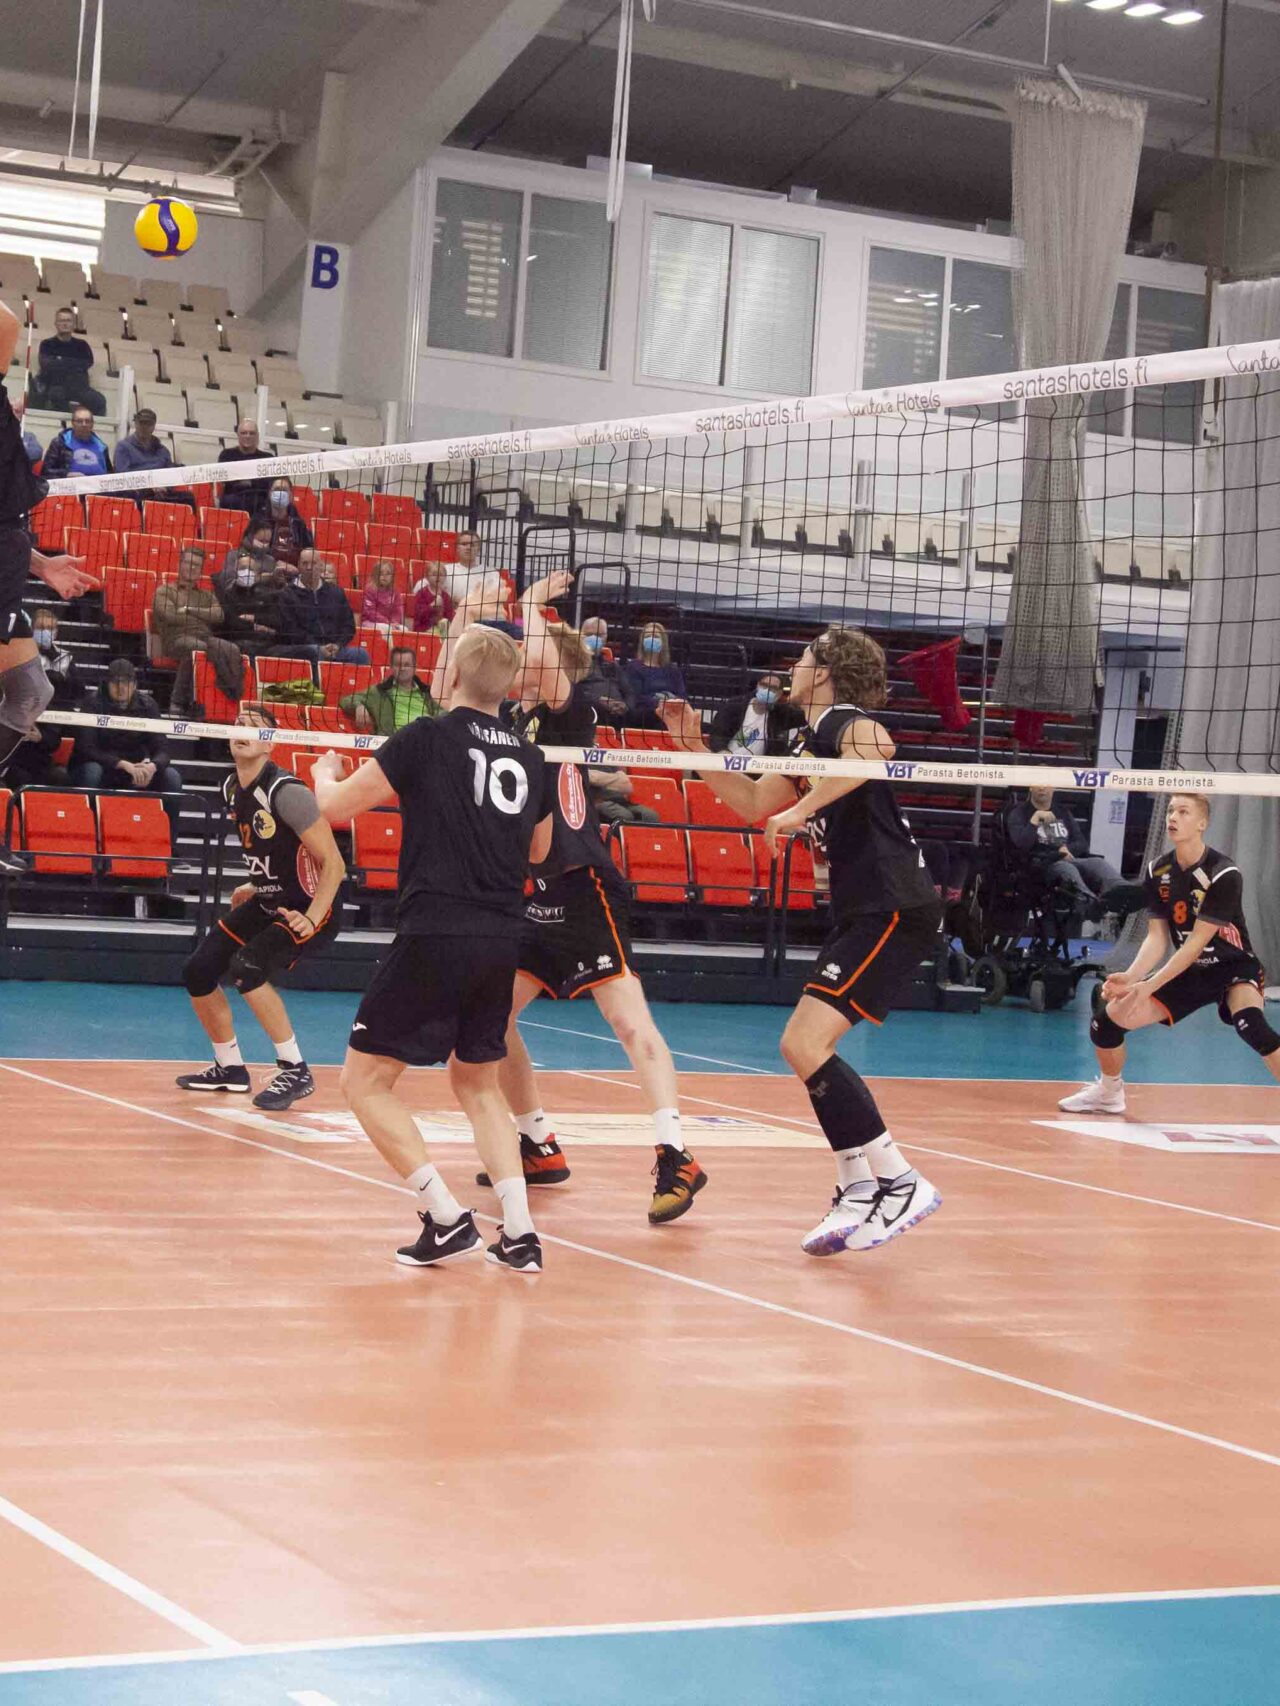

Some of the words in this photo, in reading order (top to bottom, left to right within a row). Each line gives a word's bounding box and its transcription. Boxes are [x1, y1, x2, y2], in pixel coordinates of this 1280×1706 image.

[311, 244, 339, 289] B
[1003, 357, 1149, 401] santashotels.fi
[895, 389, 942, 413] Hotels
[695, 399, 806, 433] santashotels.fi
[447, 430, 532, 460] santashotels.fi
[613, 425, 650, 442] Hotels
[256, 454, 325, 477] santashotels.fi
[354, 736, 373, 748] YBT
[583, 749, 607, 763] YBT
[723, 755, 752, 771] YBT
[752, 760, 782, 770] Parasta
[468, 748, 529, 815] 10
[884, 762, 917, 779] YBT
[917, 766, 953, 778] Parasta
[1072, 769, 1111, 788] YBT
[1112, 774, 1154, 787] Parasta
[1049, 822, 1069, 838] 76
[1173, 900, 1188, 924] 8
